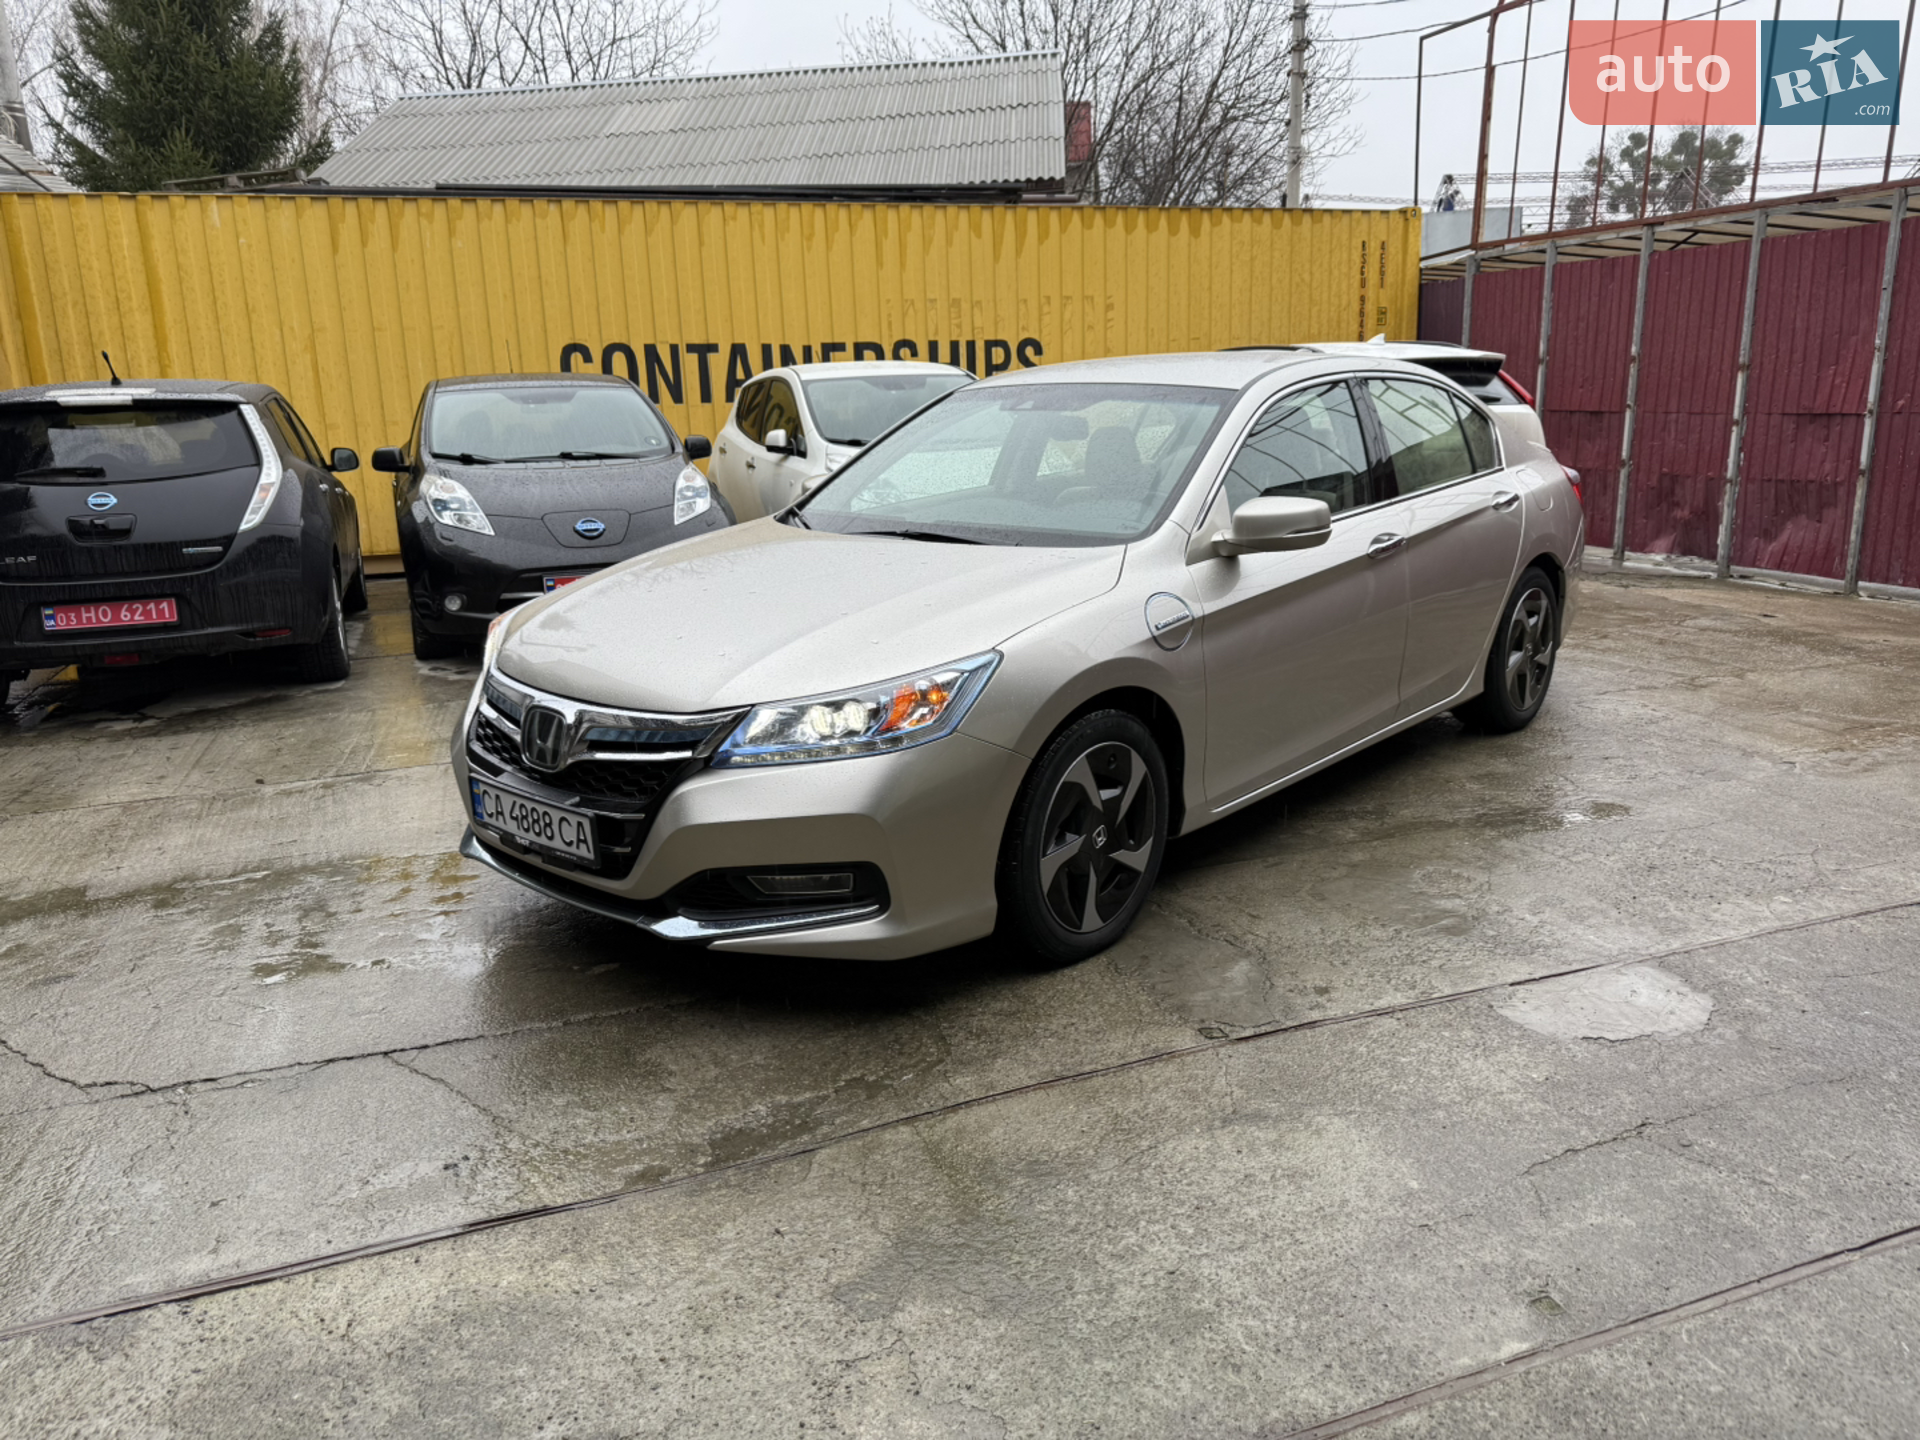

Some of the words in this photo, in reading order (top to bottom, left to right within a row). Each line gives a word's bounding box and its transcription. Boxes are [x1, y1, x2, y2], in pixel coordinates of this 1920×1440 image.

[57, 613, 77, 626] 03
[81, 606, 112, 623] HO
[120, 601, 170, 621] 6211
[481, 789, 507, 826] CA
[509, 800, 555, 841] 4888
[558, 816, 592, 854] CA
